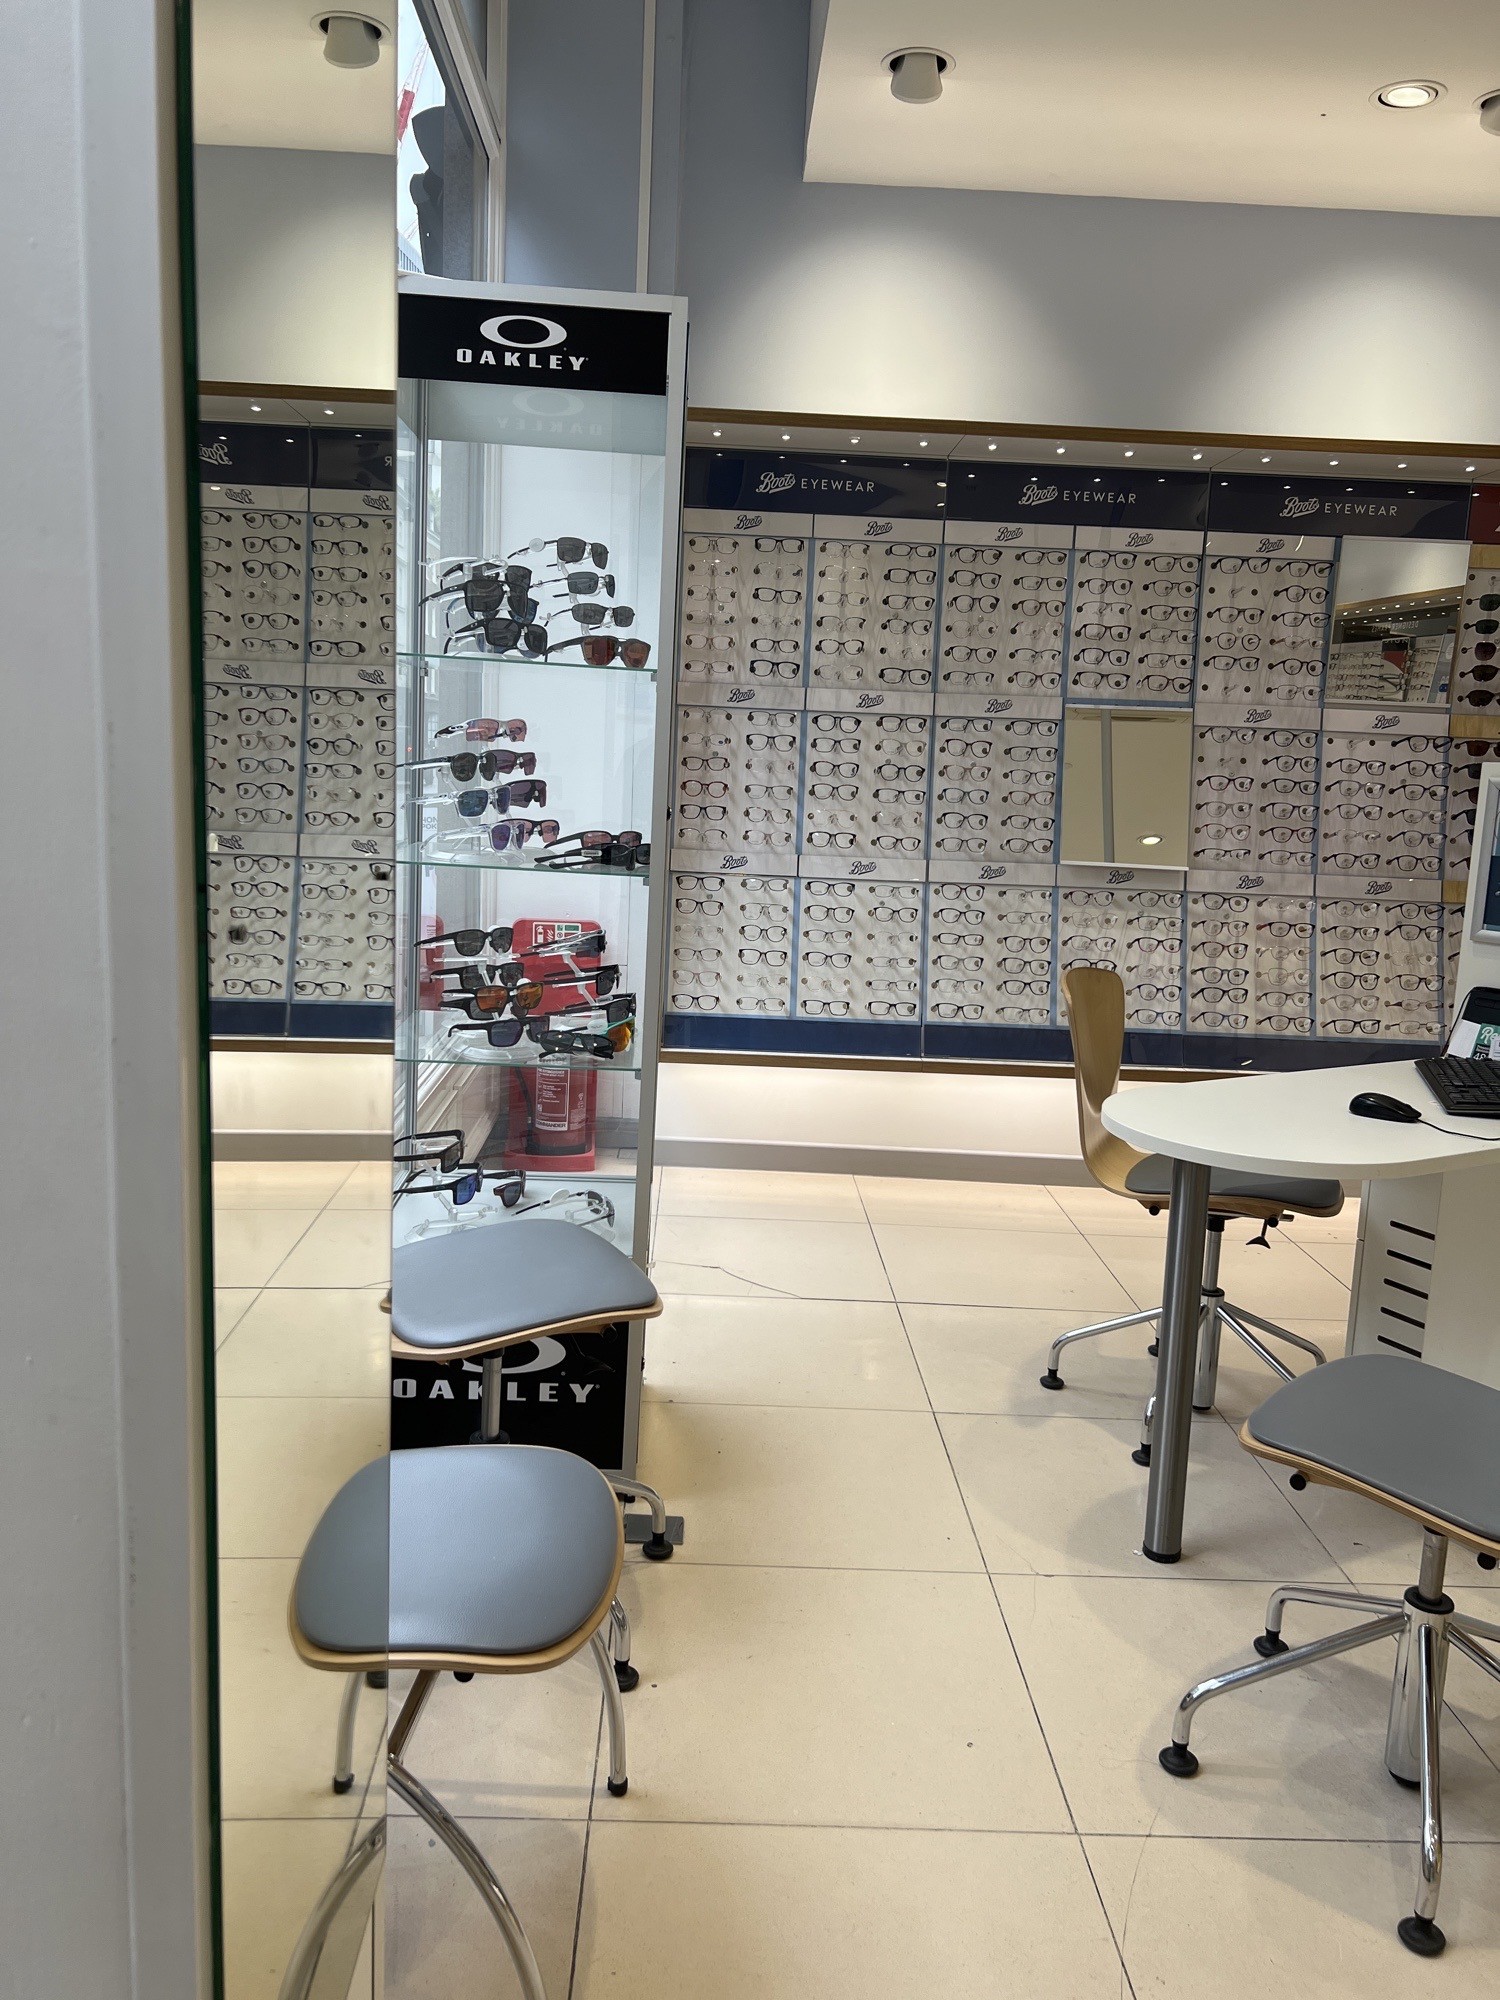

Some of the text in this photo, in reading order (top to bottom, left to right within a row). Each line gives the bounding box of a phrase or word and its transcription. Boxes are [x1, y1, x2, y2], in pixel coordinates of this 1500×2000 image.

[456, 347, 587, 371] OAKLEY
[755, 471, 875, 494] Boots EYEWEAR
[1017, 484, 1137, 507] Boots EYEWEAR
[1278, 496, 1398, 519] Boots EYEWEAR
[733, 514, 763, 531] Boots
[863, 520, 893, 537] Boots
[994, 526, 1024, 543] Boots
[1124, 532, 1155, 548] Boots
[1255, 537, 1285, 554] Boots
[726, 687, 756, 704] Boots
[855, 693, 885, 709] Boots
[984, 698, 1014, 714] Boots
[1243, 708, 1273, 724] Boots
[1371, 714, 1401, 730] Boots
[719, 854, 749, 870] Boots
[848, 860, 877, 876] Boots
[977, 865, 1007, 881] Boots
[1107, 869, 1136, 885] Boots
[1235, 875, 1265, 890] Boots
[1364, 880, 1393, 896] Boots
[393, 1378, 595, 1404] OAKLEY
